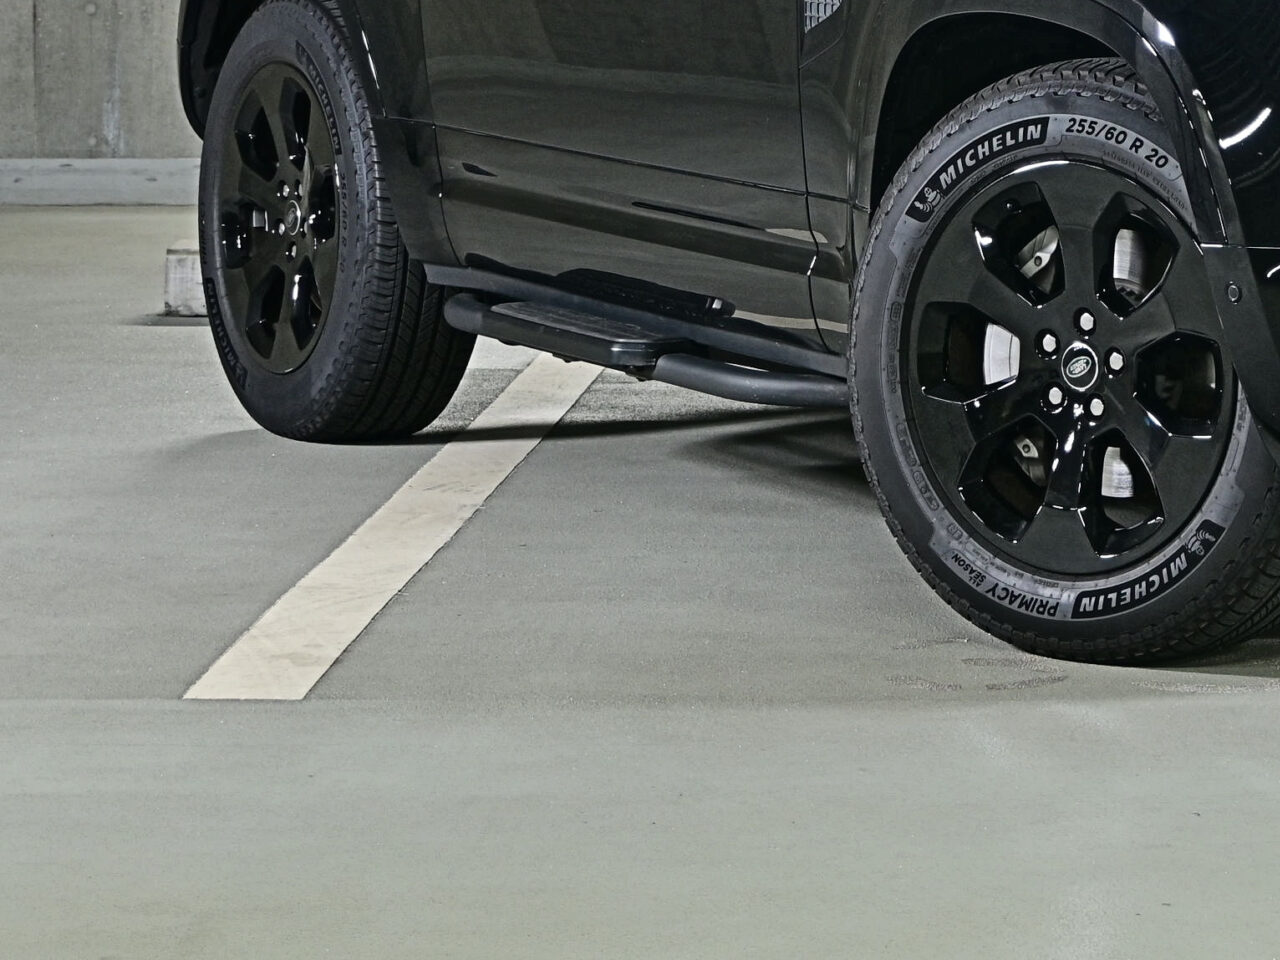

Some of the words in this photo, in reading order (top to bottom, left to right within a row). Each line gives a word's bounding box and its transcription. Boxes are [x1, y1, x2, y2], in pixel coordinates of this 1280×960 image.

[939, 123, 1042, 190] MICHELIN
[1065, 117, 1128, 145] 255/60
[1128, 136, 1145, 155] R
[1144, 147, 1169, 169] 20
[951, 553, 987, 584] SEASON
[968, 576, 982, 588] ALL
[1079, 552, 1188, 612] MICHELIN
[985, 582, 1060, 618] PRIMACY
